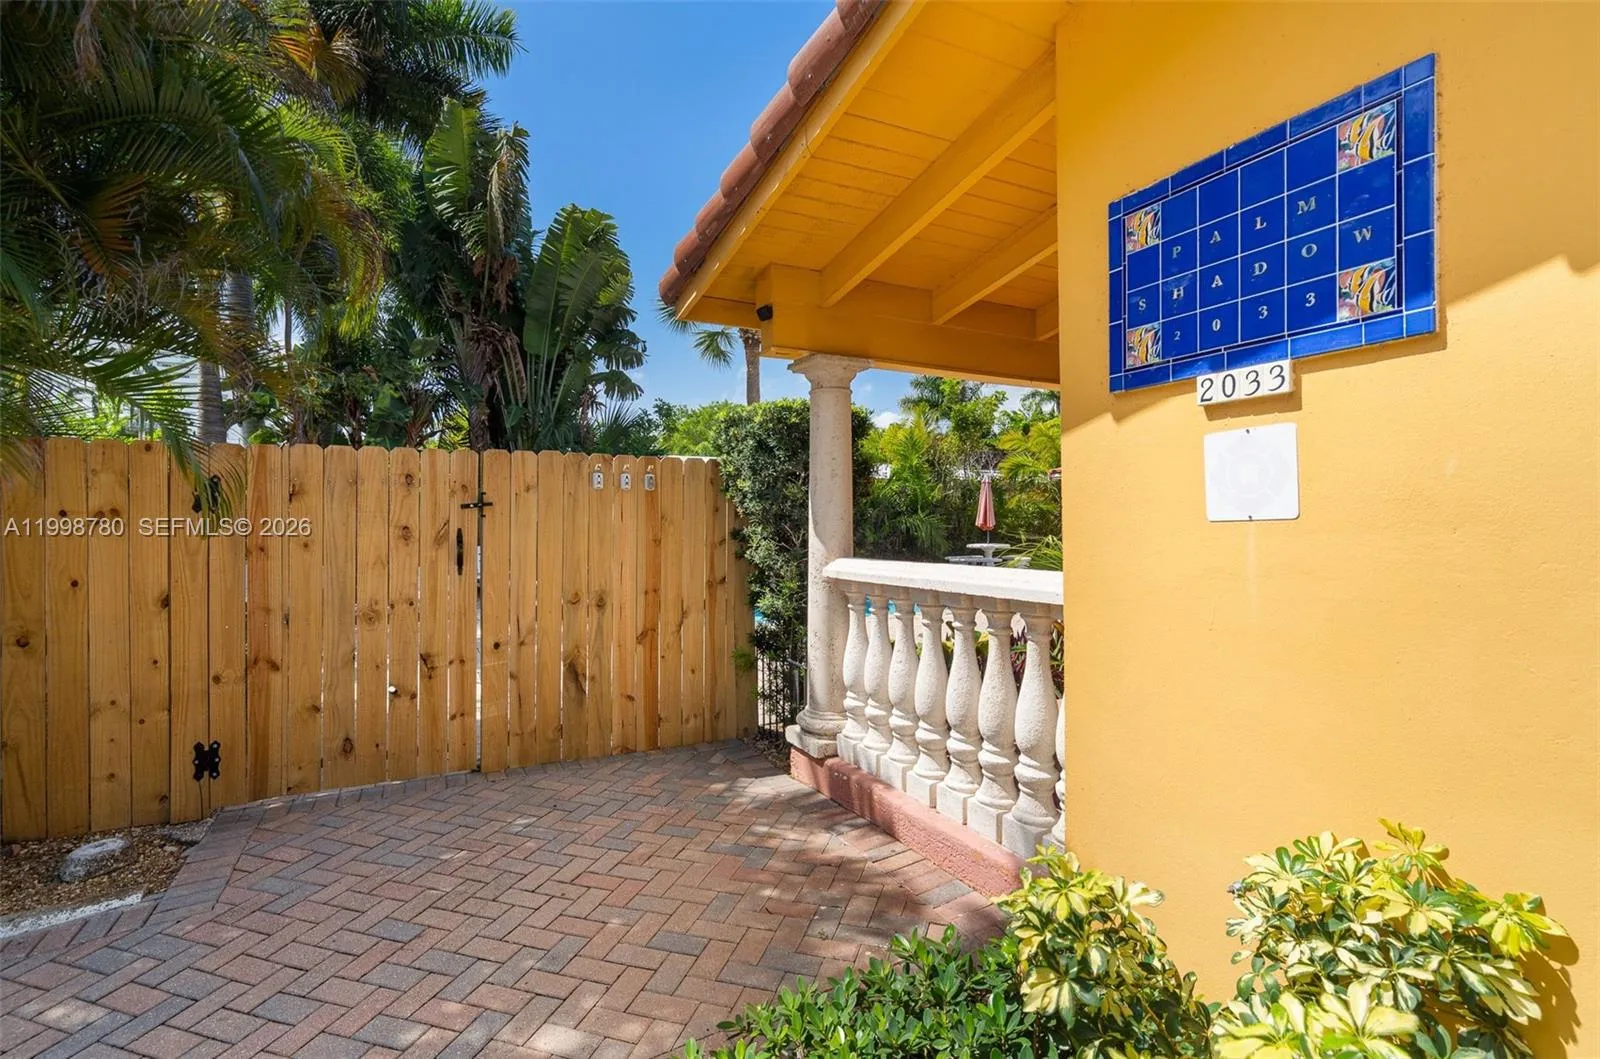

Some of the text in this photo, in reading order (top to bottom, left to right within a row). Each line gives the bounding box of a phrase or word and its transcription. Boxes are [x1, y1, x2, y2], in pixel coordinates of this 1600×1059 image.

[1173, 197, 1316, 258] PALM
[1139, 226, 1371, 311] SHADOW
[1174, 292, 1316, 340] 2033
[1200, 364, 1285, 402] 2033
